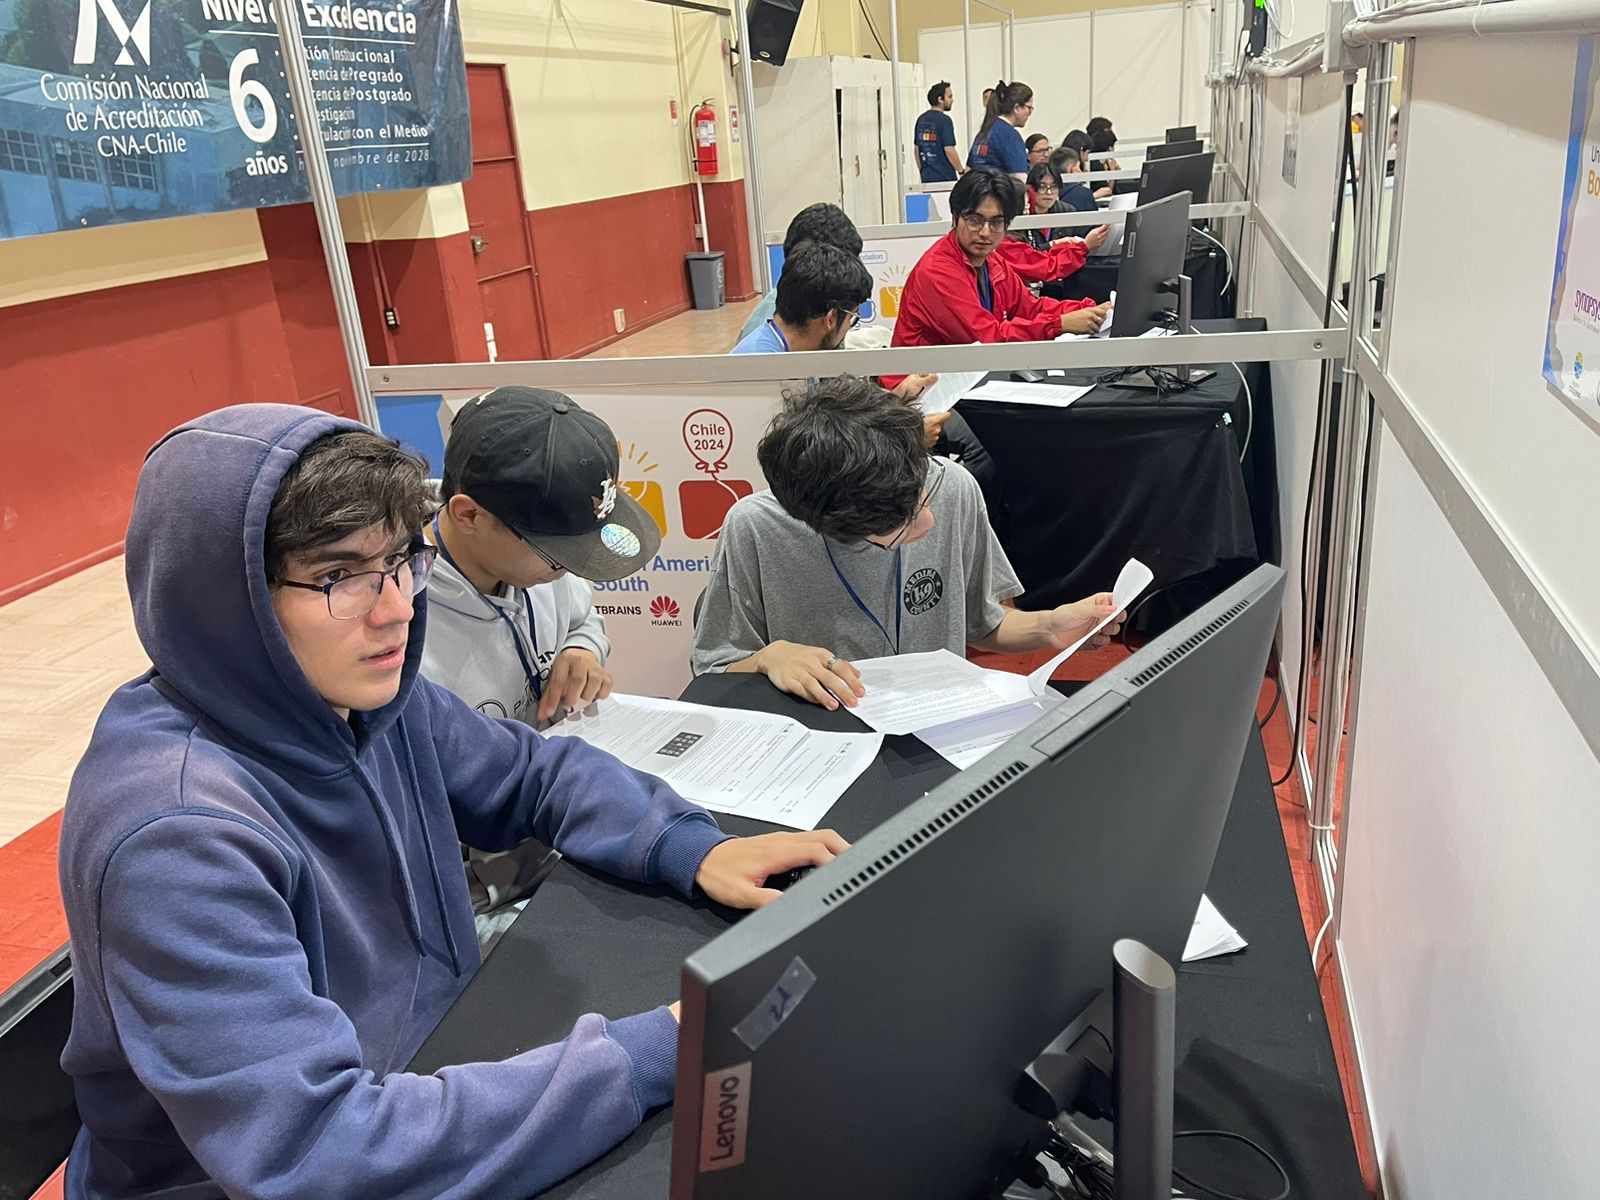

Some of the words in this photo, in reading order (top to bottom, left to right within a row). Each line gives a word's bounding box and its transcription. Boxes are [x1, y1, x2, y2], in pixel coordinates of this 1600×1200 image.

[202, 0, 268, 24] Nivel
[302, 0, 416, 34] Excelencia
[40, 73, 133, 101] Comisión
[135, 73, 209, 99] Nacional
[229, 48, 278, 143] 6
[65, 104, 88, 131] de
[94, 101, 204, 130] Acreditación
[379, 124, 391, 138] el
[394, 124, 428, 138] Medio
[97, 132, 187, 157] CNA-Chile
[386, 151, 400, 163] de
[245, 151, 289, 176] años
[690, 424, 725, 436] Chile
[694, 439, 725, 450] 2024
[653, 555, 710, 572] Ameri
[595, 605, 642, 615] TBRAINS
[709, 1075, 740, 1162] Lenovo
